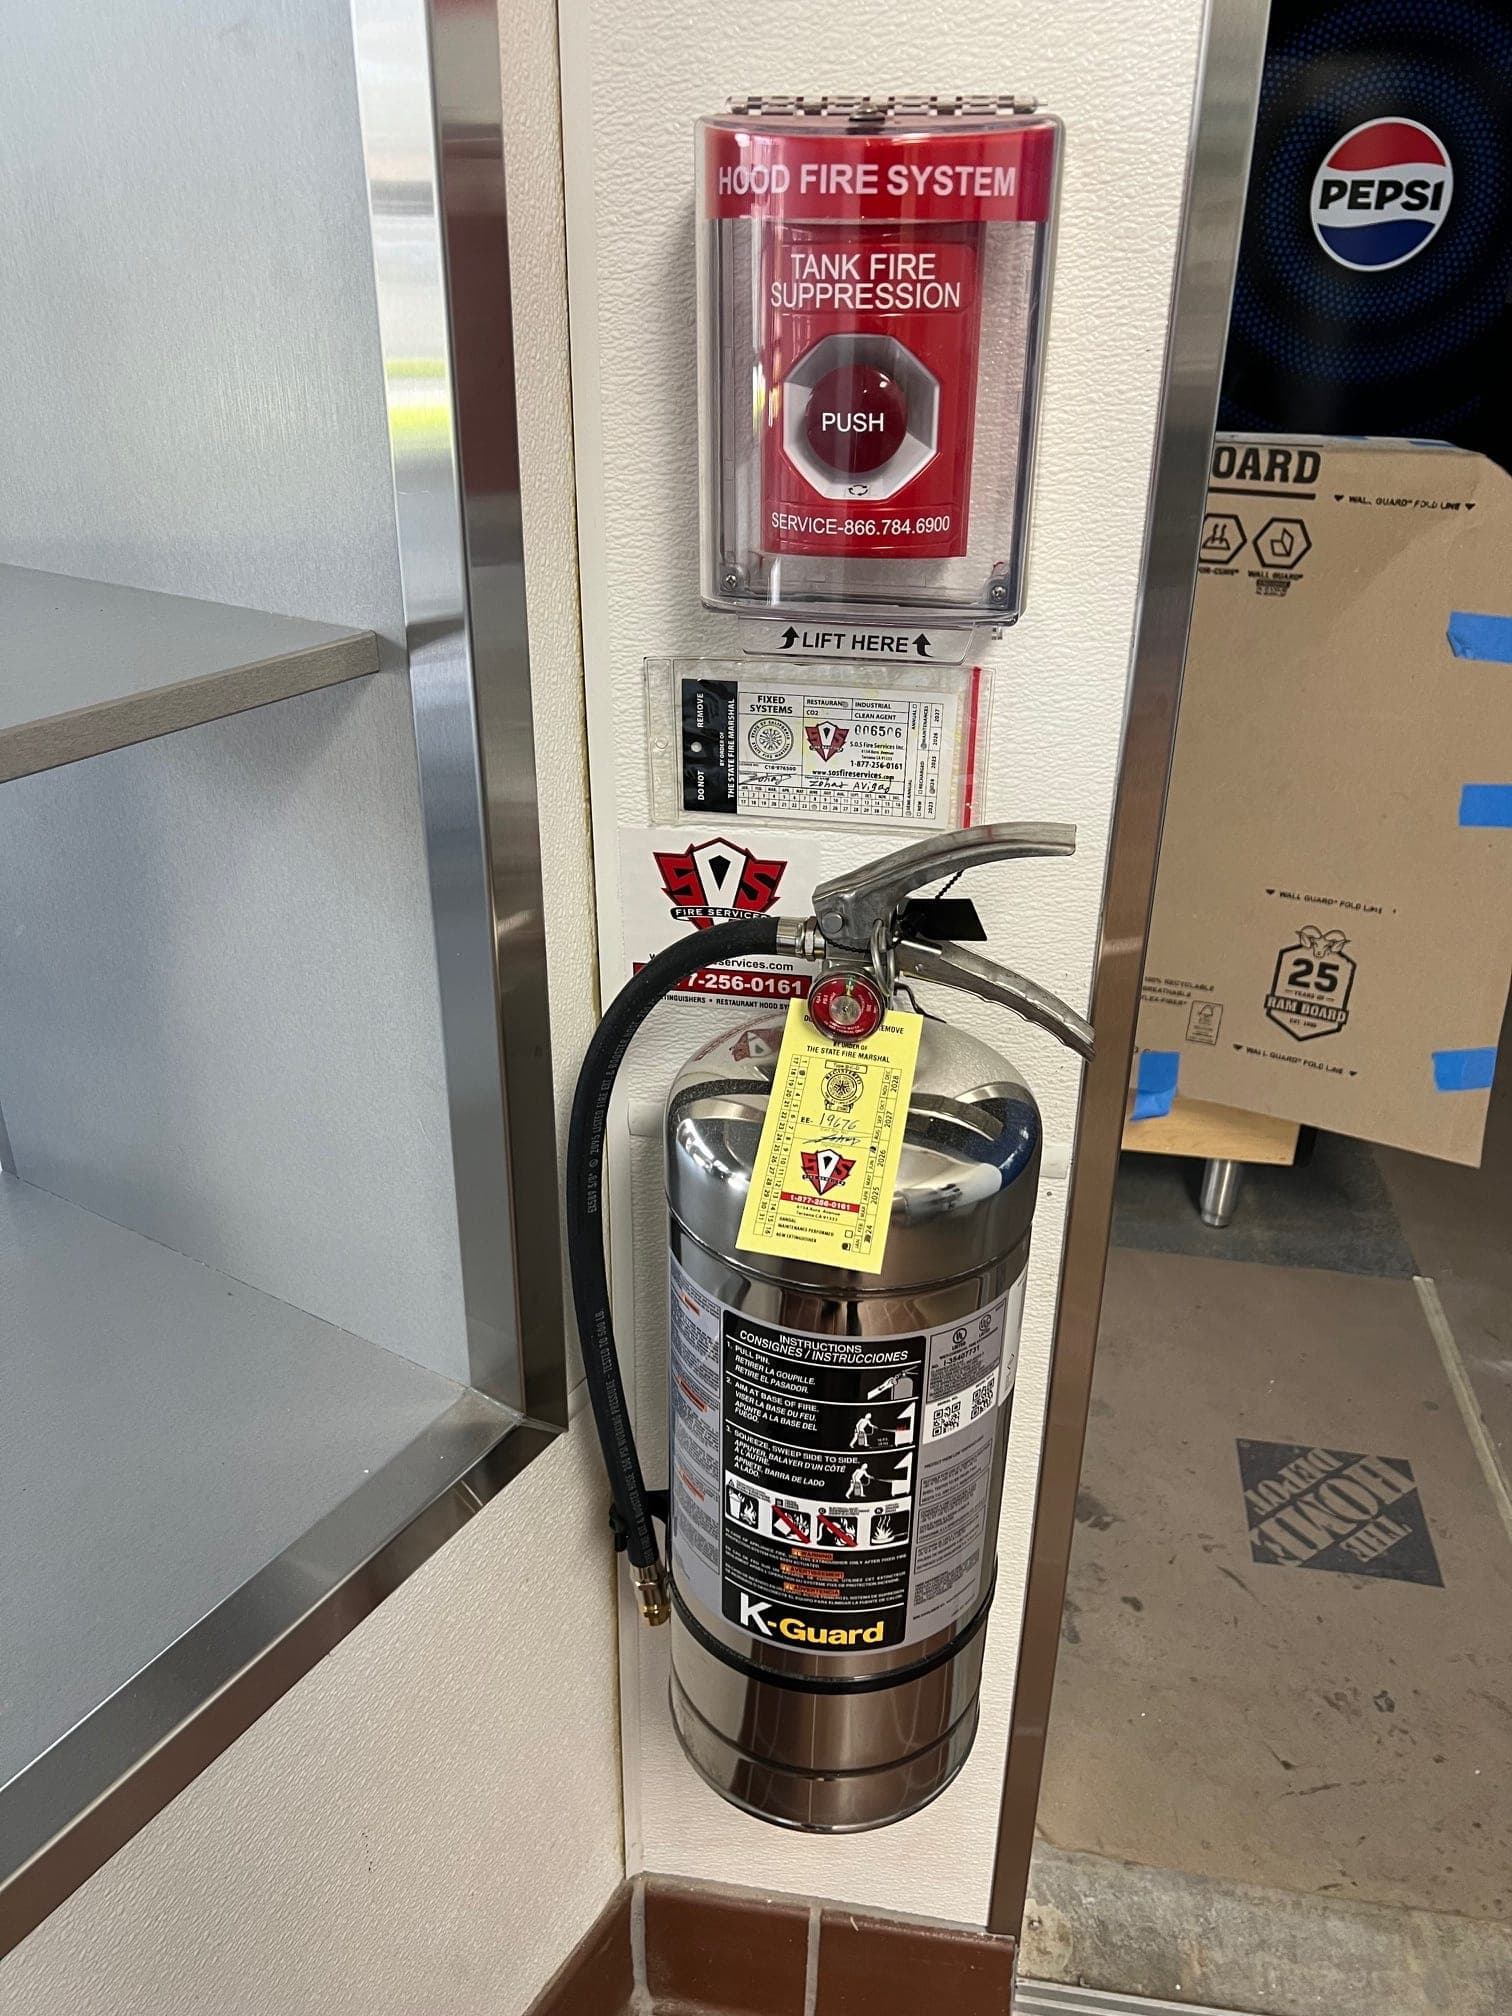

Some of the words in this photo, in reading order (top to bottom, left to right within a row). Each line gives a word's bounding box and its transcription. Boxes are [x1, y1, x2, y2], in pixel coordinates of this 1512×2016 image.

[719, 165, 790, 195] HOOD
[800, 164, 879, 195] FIRE
[887, 165, 1016, 196] SYSTEM
[1319, 179, 1445, 211] PEPSI
[791, 254, 861, 280] TANK
[870, 254, 936, 280] FIRE
[771, 282, 960, 309] SUPPRESSION
[821, 412, 884, 433] PUSH
[1212, 446, 1321, 484] OARD
[771, 512, 950, 536] SERVICE-866.784.6900
[802, 632, 845, 649] LIFT
[852, 634, 909, 653] HERE
[749, 704, 793, 714] SYSTEMS
[757, 695, 785, 704] FIXED
[806, 699, 848, 708] RESTAURAN
[863, 741, 872, 749] Fire
[812, 769, 894, 780] www.sosfireservices.com
[850, 760, 903, 770] 1-877-256-0161
[698, 787, 705, 800] DO
[676, 908, 703, 916] FIRE
[687, 973, 802, 995] 7-256-0161
[1288, 958, 1339, 993] 25
[716, 999, 758, 1008] RESTAURANT
[759, 1002, 777, 1010] HOOD
[1267, 996, 1297, 1012] RAM
[1301, 1002, 1346, 1023] BOARD
[841, 1050, 857, 1058] FIRE
[858, 1053, 890, 1063] MARSHAL
[890, 1076, 899, 1093] 2028
[884, 1111, 893, 1128] 2027
[877, 1149, 886, 1167] 2026
[871, 1186, 880, 1205] 2025
[739, 1330, 803, 1357] CONSIGNES
[804, 1350, 811, 1359] /
[812, 1350, 908, 1364] INSTRUCCIONES
[779, 1334, 862, 1353] INSTRUCTIONS
[735, 1345, 754, 1359] PULL
[755, 1353, 770, 1365] PIN.
[735, 1355, 765, 1372] RETIRER
[765, 1364, 775, 1375] LA
[778, 1370, 816, 1386] GOUPILLE.
[735, 1364, 759, 1380] RETIRE
[760, 1373, 769, 1383] EL
[771, 1378, 809, 1394] PASADOR.
[725, 1376, 732, 1386] 2.
[734, 1382, 749, 1394] AIM
[749, 1387, 759, 1397] AT
[761, 1391, 782, 1405] BASE
[784, 1399, 797, 1408] OF
[798, 1402, 819, 1413] FIRE.
[734, 1407, 760, 1423] FUEGO.
[734, 1401, 762, 1417] APUNTE
[769, 1414, 779, 1422] LA
[780, 1417, 800, 1429] BASE
[802, 1422, 818, 1431] DEL
[735, 1391, 755, 1406] VISER
[755, 1400, 764, 1408] LA
[766, 1403, 785, 1415] BASE
[787, 1409, 799, 1418] DU
[799, 1412, 817, 1422] FEU.
[734, 1429, 771, 1450] SQUEEZE,
[772, 1444, 801, 1458] SWEEP
[803, 1452, 822, 1462] SIDE
[824, 1455, 837, 1463] TO
[838, 1456, 860, 1464] SIDE.
[741, 1465, 760, 1479] LADO.
[769, 1453, 803, 1468] BALAYER
[804, 1462, 822, 1471] D'UN
[764, 1467, 790, 1481] BARRA
[791, 1474, 801, 1483] DE
[803, 1477, 825, 1488] LADO
[1243, 1448, 1344, 1516] DEPOT
[1250, 1455, 1417, 1567] HOME
[1339, 1515, 1413, 1563] THE
[802, 1551, 832, 1560] WARNING
[740, 1592, 884, 1645] K-Guard
